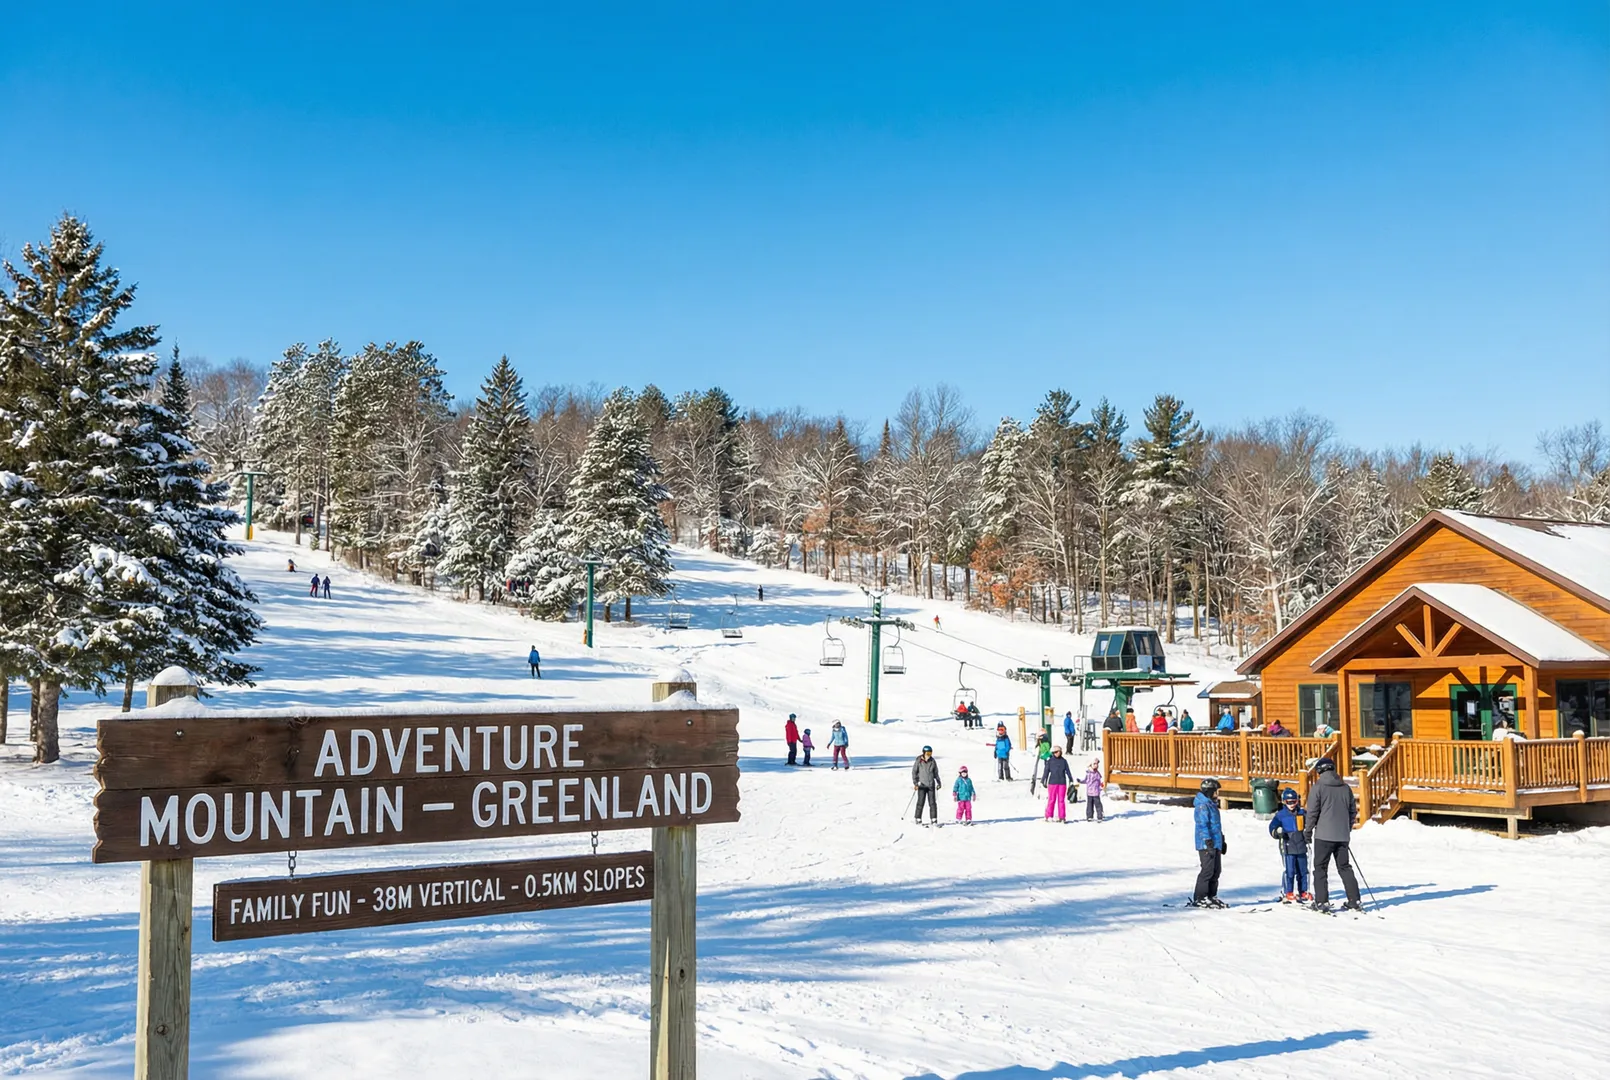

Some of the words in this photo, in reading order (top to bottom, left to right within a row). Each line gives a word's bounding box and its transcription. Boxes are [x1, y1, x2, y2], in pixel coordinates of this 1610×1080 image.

[314, 723, 585, 778] ADVENTURE
[139, 785, 405, 848] MOUNTAIN
[471, 771, 713, 828] GREENLAND
[230, 893, 305, 925] FAMILY
[311, 890, 351, 918] FUN
[372, 884, 412, 912] 38M
[418, 877, 506, 907] VERTICAL
[524, 871, 577, 898] 0.5KM
[583, 865, 645, 893] SLOPES
